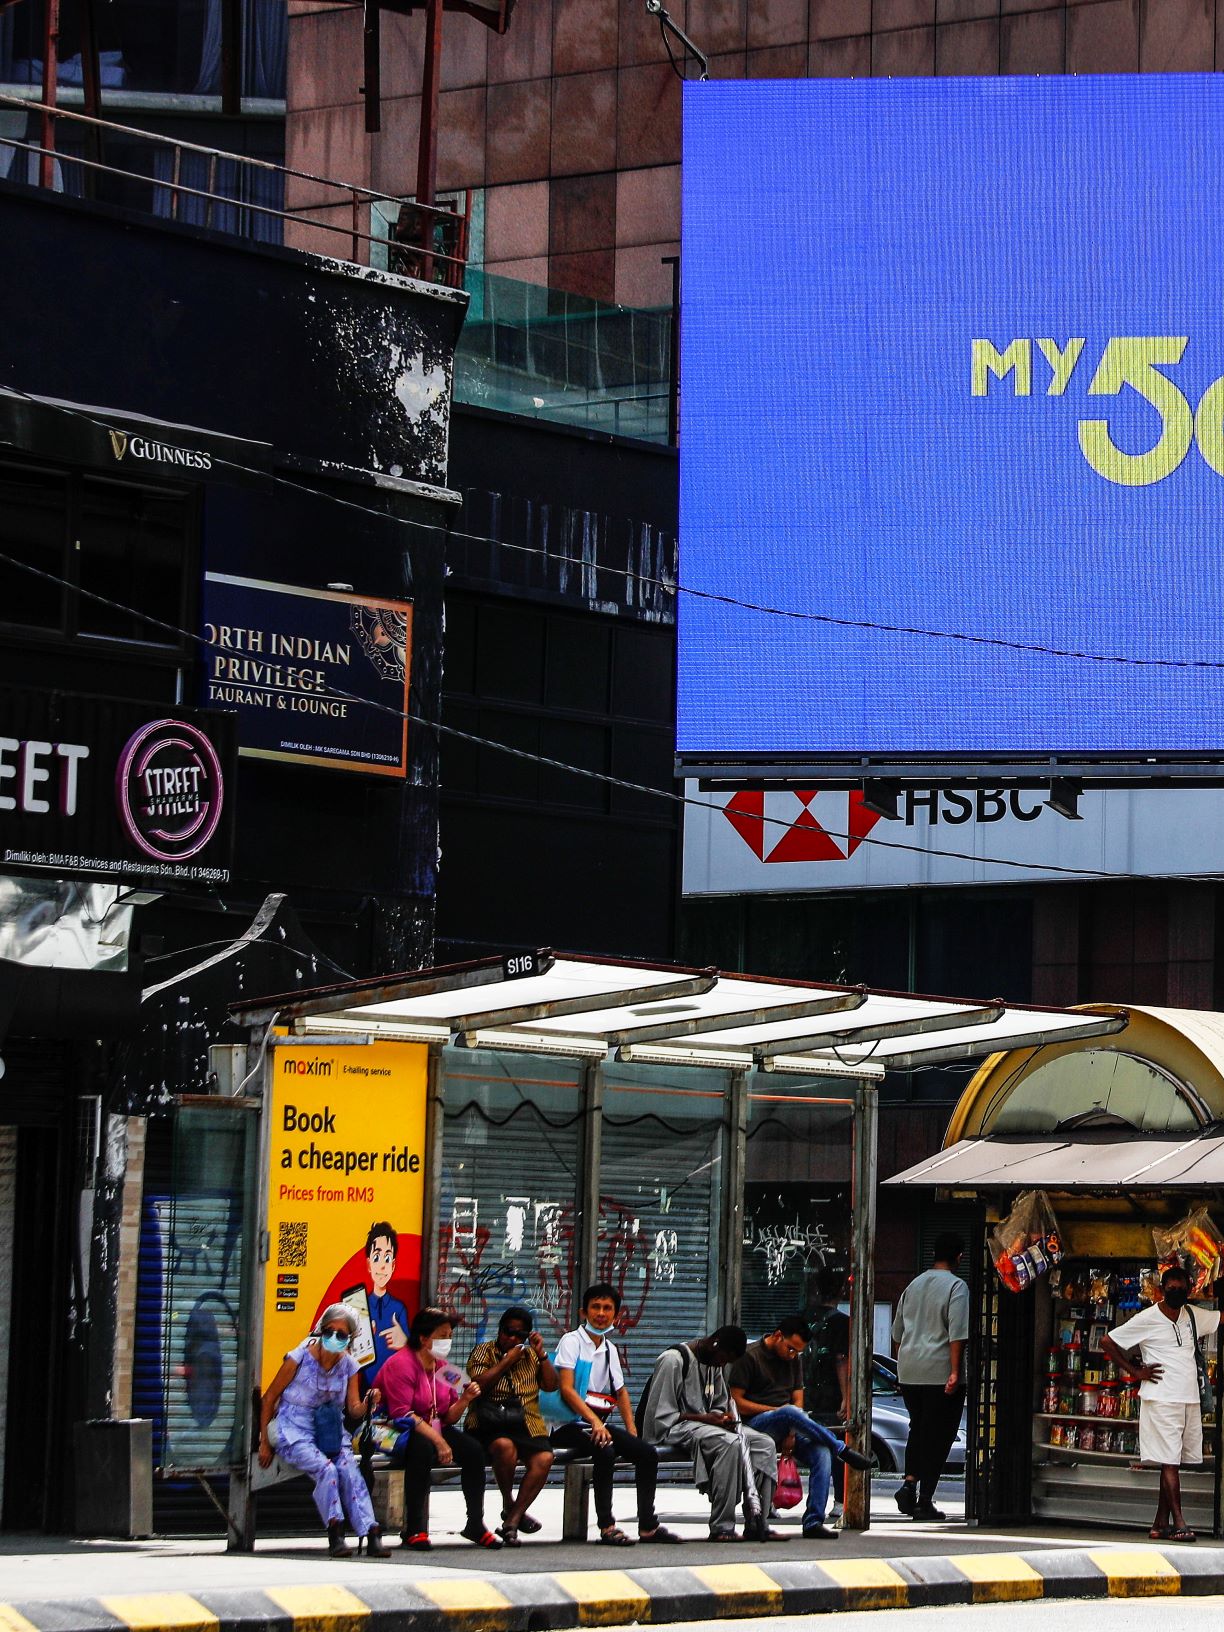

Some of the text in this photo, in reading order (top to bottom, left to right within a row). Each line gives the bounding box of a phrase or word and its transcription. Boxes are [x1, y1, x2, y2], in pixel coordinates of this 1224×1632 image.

[971, 338, 1086, 396] MY
[130, 437, 212, 470] GUINNESS
[271, 633, 351, 667] INDIAN
[214, 655, 326, 692] PRIVILEGE
[276, 695, 287, 710] &
[290, 697, 348, 719] LOUNGE
[80, 855, 109, 870] Services
[109, 861, 121, 871] and
[122, 860, 160, 875] Restaurants
[370, 1067, 392, 1077] service
[283, 1104, 337, 1133] Book
[281, 1142, 420, 1176] a cheaper ride
[279, 1184, 375, 1203] Prices from RM3
